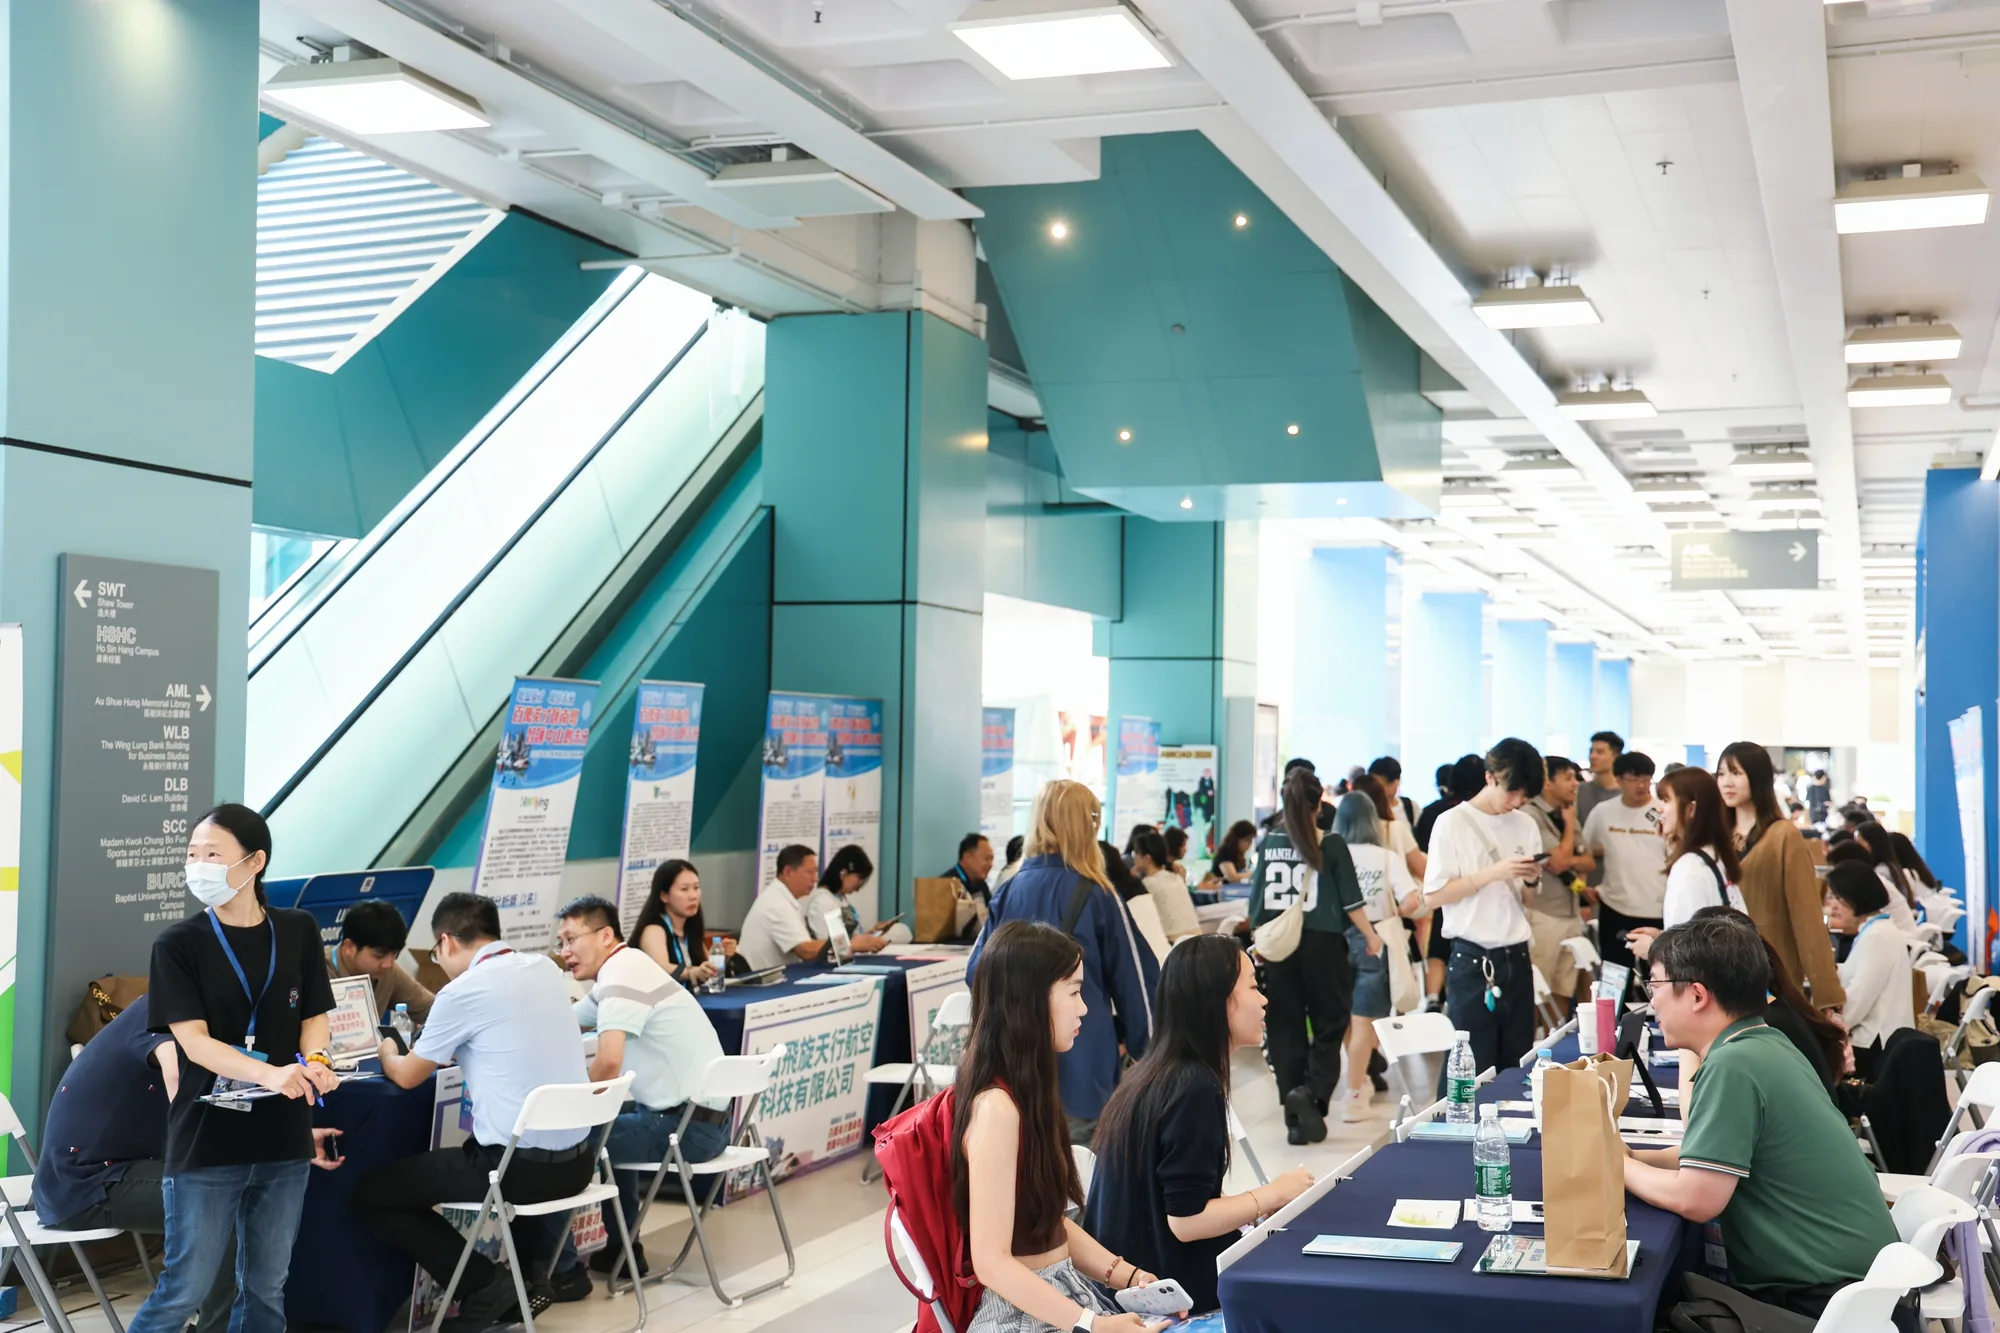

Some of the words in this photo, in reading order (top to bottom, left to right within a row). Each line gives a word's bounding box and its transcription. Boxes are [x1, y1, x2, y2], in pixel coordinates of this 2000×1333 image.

[98, 581, 126, 597] SWT
[97, 597, 115, 607] Shaw
[116, 599, 134, 609] Tower
[97, 625, 137, 645] HSHC
[96, 643, 105, 653] Ho
[107, 644, 117, 653] Sin
[118, 645, 134, 657] Hang
[135, 646, 159, 658] Campus
[166, 684, 191, 698] AML
[95, 697, 104, 706] Au
[106, 697, 122, 707] Shue
[124, 698, 140, 709] Hung
[142, 698, 169, 708] Memorial
[170, 699, 191, 710] Library
[163, 725, 190, 739] WLB
[101, 740, 114, 749] The
[115, 741, 131, 752] Wing
[132, 741, 148, 752] Lung
[149, 741, 164, 750] Bank
[166, 741, 190, 752] Building
[128, 751, 137, 760] for
[138, 752, 165, 761] Business
[167, 752, 189, 761] Studies
[165, 777, 188, 792] DLB
[121, 794, 140, 804] David
[141, 793, 148, 803] C.
[149, 794, 163, 803] Lam
[164, 793, 188, 804] Building
[163, 819, 187, 834] SCC
[100, 838, 124, 847] Madam
[126, 837, 143, 846] Kwok
[144, 836, 164, 846] Chung
[165, 835, 174, 844] Bo
[175, 835, 187, 844] Fun
[107, 848, 127, 859] Sports
[129, 848, 140, 857] and
[142, 846, 165, 856] Cultural
[166, 845, 187, 855] Centre
[1264, 847, 1302, 861] MANHA
[147, 871, 186, 891] BURC
[115, 893, 137, 904] Baptist
[138, 891, 168, 901] University
[169, 889, 185, 899] Road
[160, 901, 185, 910] Campus
[755, 1020, 875, 1079] 飛旋天行航空
[759, 1063, 856, 1123] 科技有限公司
